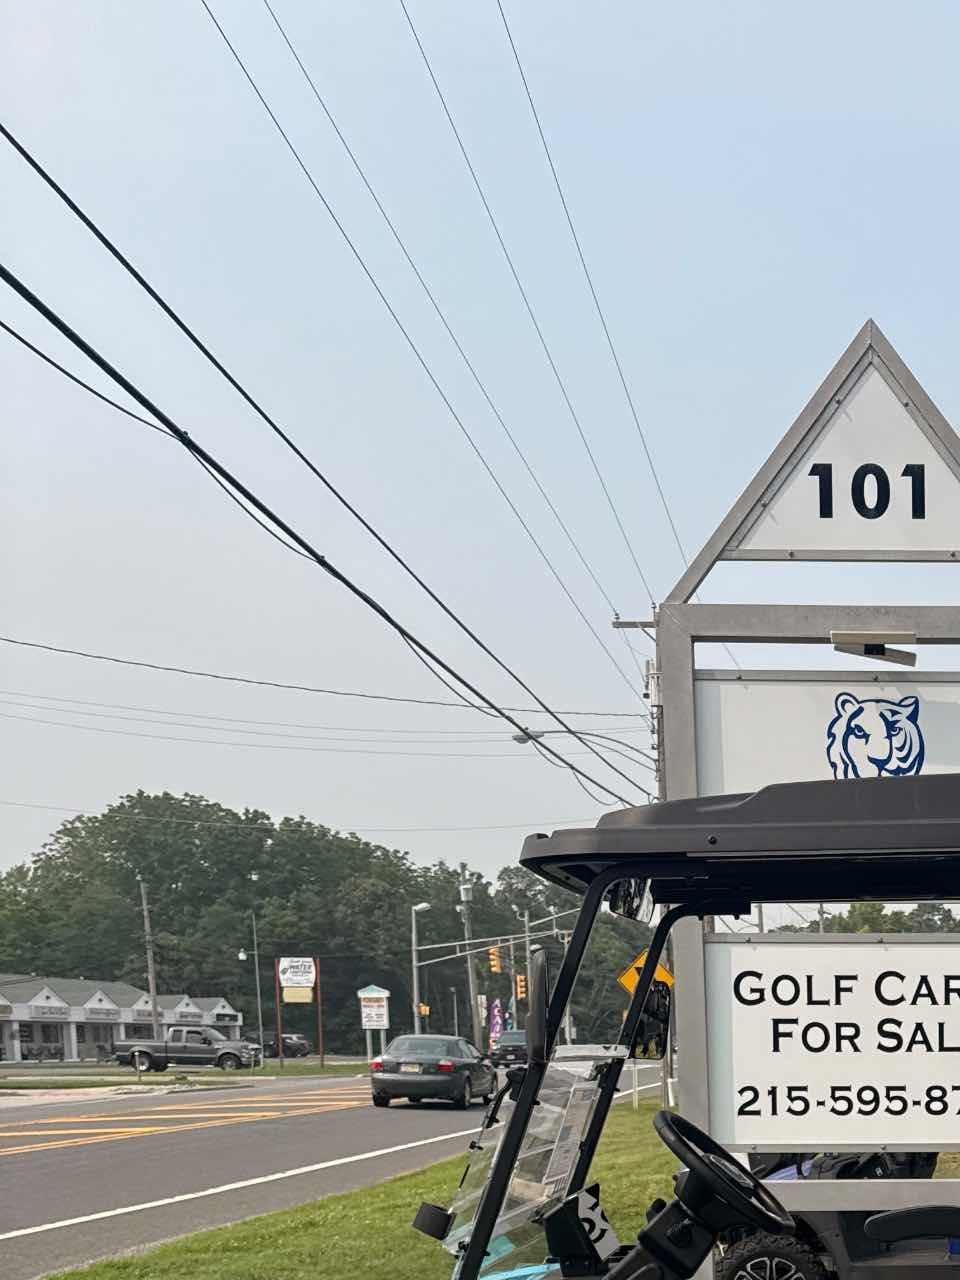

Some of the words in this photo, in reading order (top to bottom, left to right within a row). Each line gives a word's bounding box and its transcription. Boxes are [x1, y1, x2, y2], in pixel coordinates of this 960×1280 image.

[808, 462, 926, 520] 101
[734, 971, 858, 1005] GOLF
[772, 1018, 861, 1053] FOR
